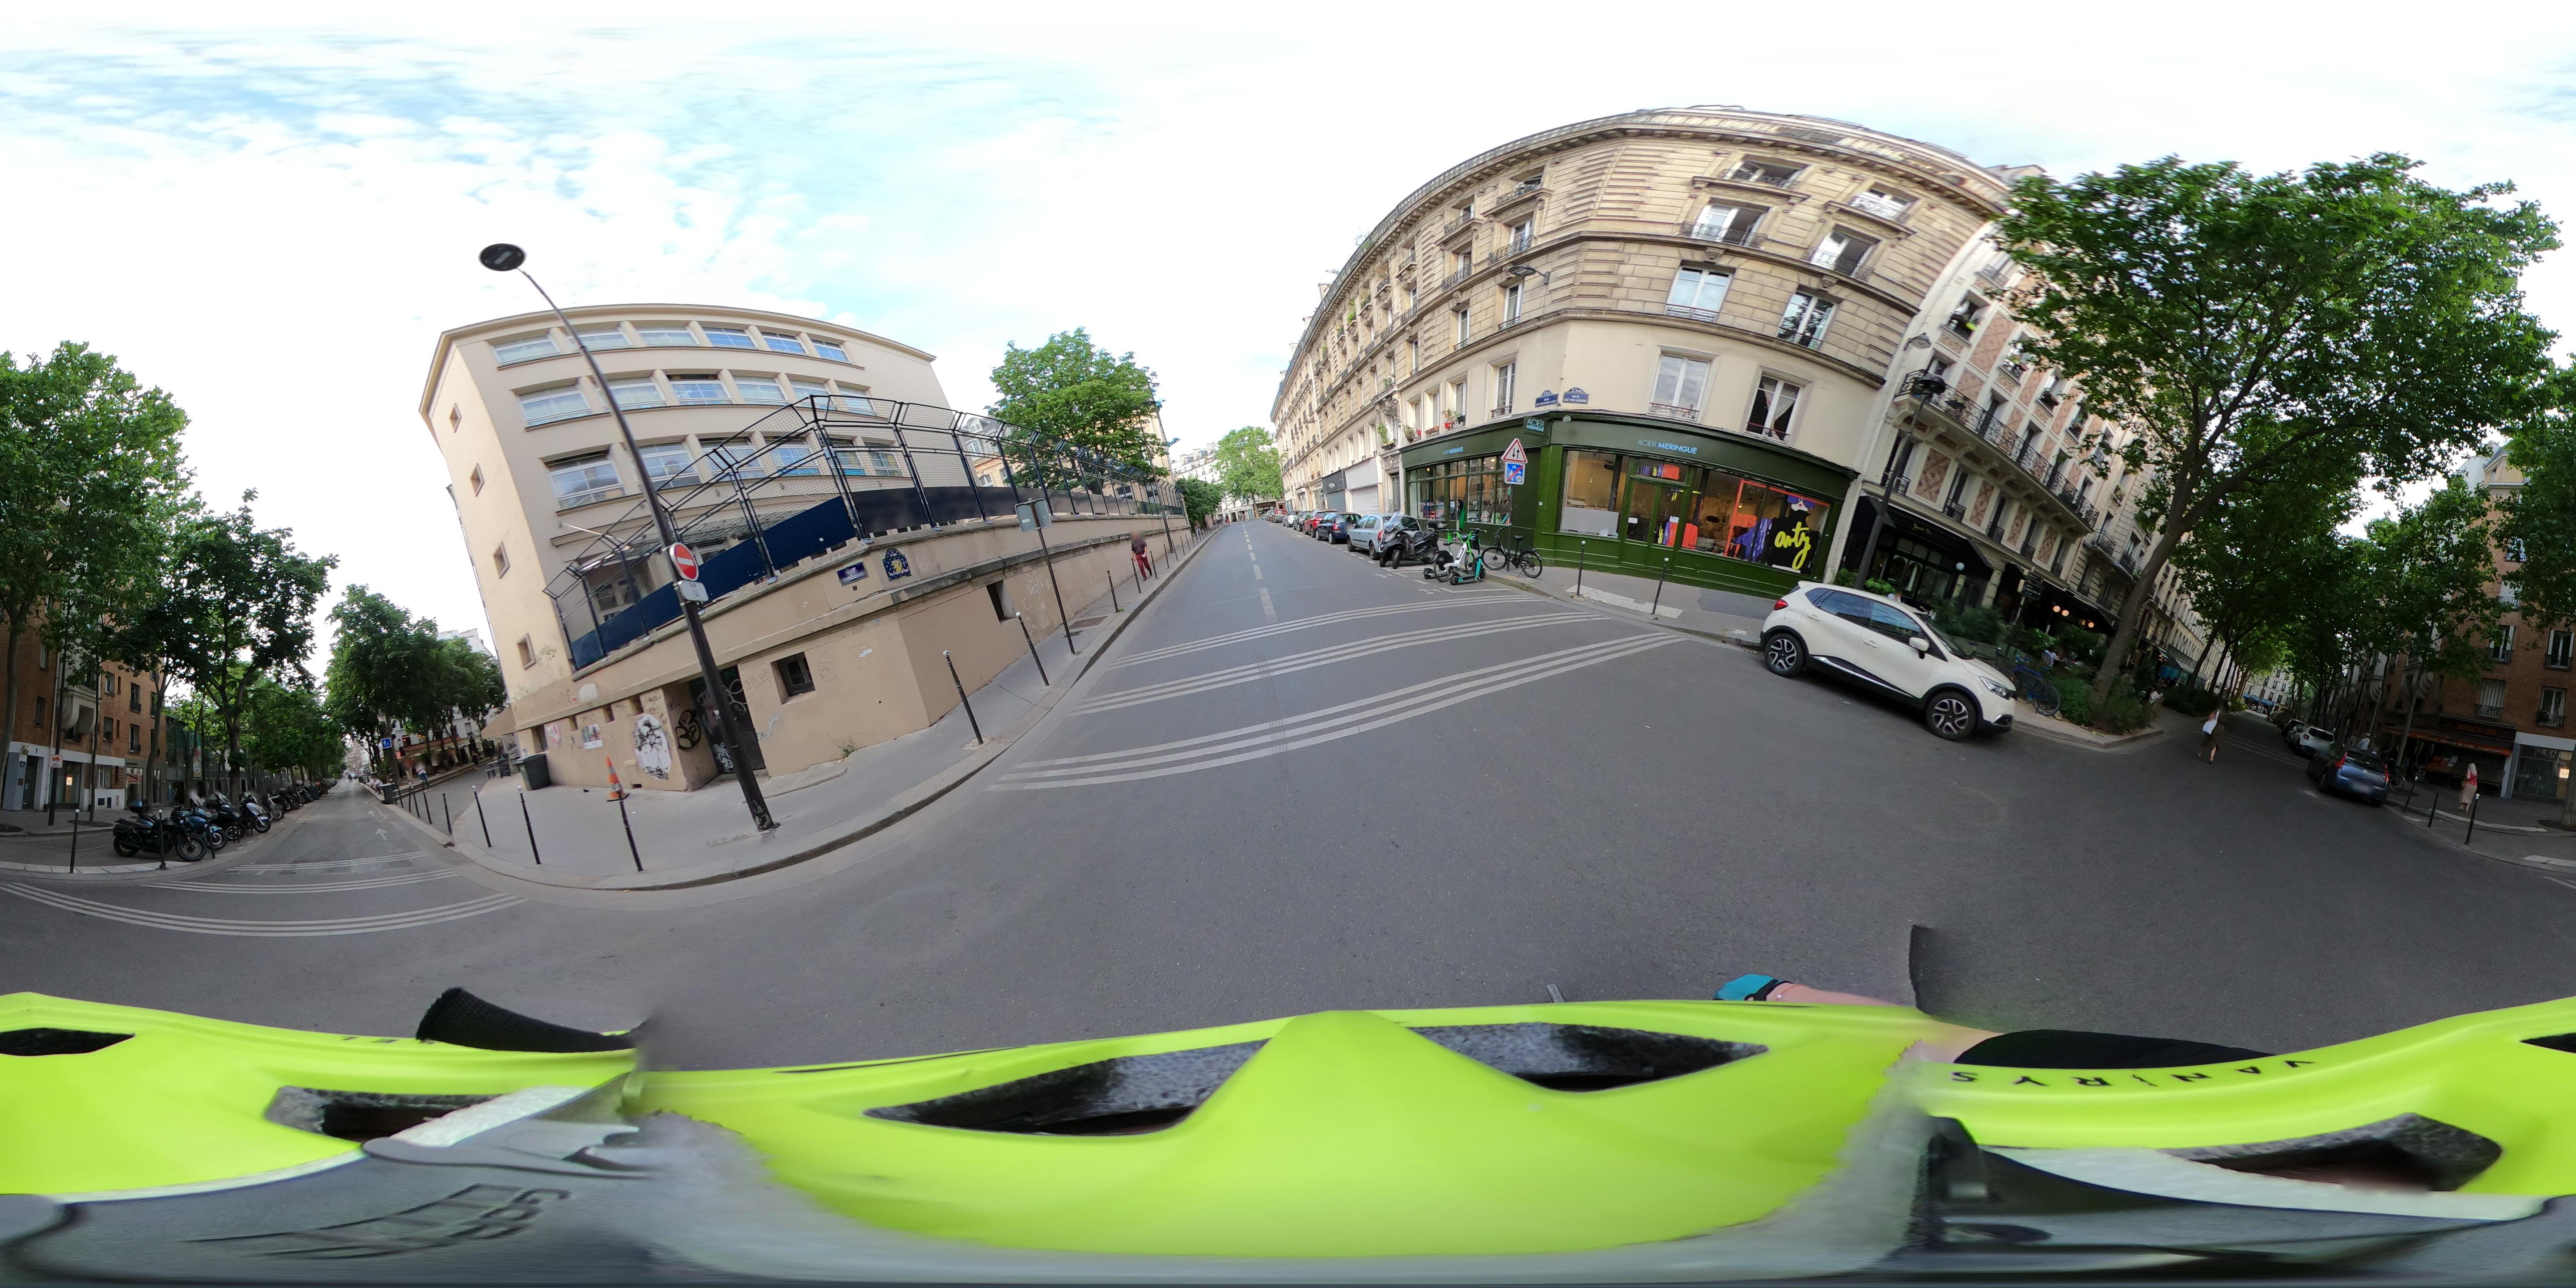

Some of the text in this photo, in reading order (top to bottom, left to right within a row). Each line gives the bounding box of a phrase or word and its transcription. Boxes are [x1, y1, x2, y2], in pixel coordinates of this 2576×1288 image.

[1527, 418, 1544, 427] ACIER
[1449, 446, 1464, 454] MERINGUE
[1637, 439, 1698, 454] ACIER MERINGUE
[2485, 729, 2497, 737] COIN
